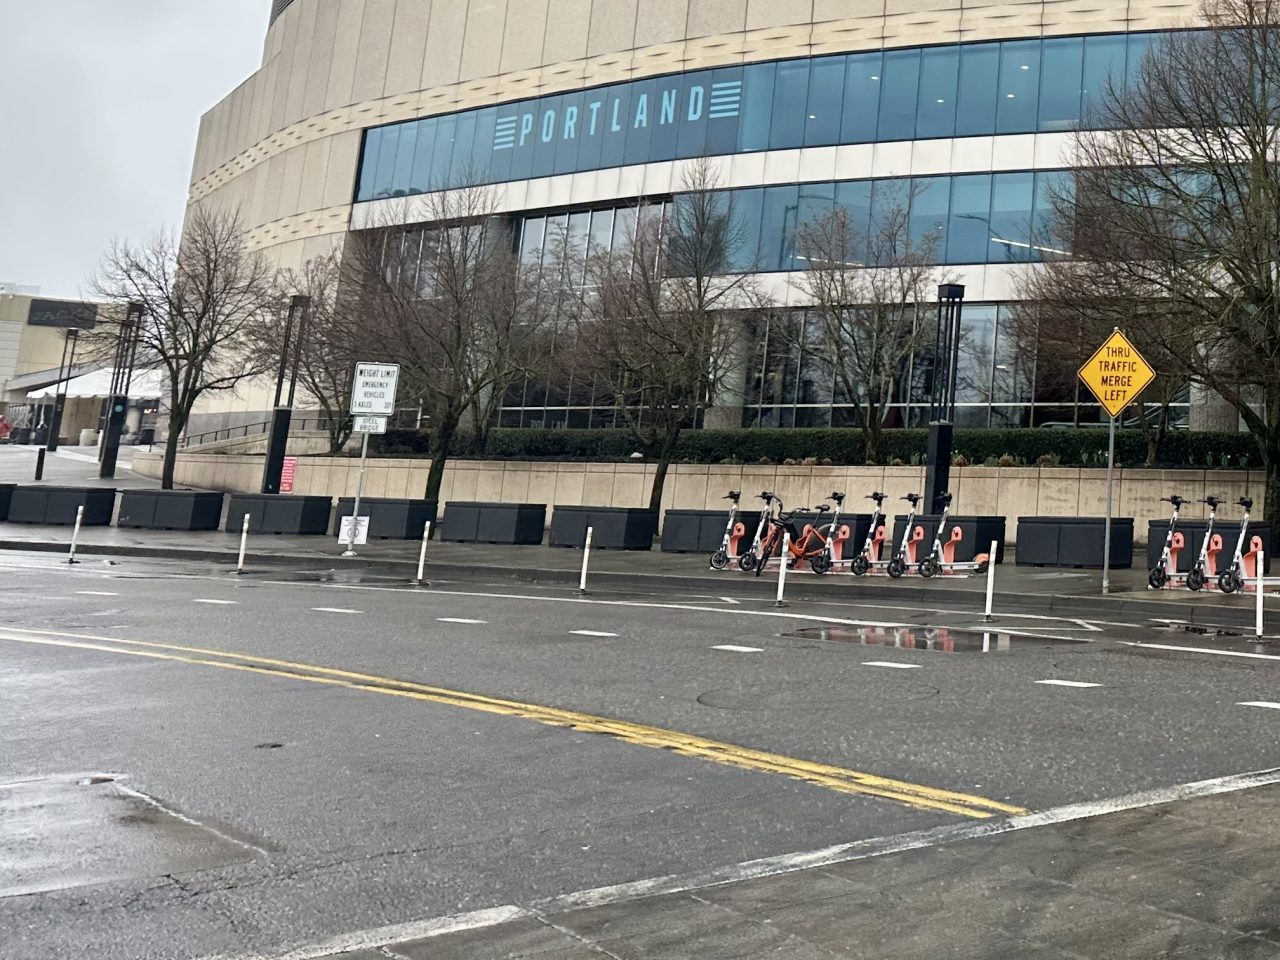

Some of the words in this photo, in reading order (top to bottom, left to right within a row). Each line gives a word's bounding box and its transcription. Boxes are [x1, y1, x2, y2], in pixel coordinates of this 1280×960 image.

[519, 85, 705, 147] PORTLAND
[1106, 346, 1131, 358] THRU
[1099, 361, 1137, 373] TRAFFIC
[359, 368, 379, 378] WEIGHT
[381, 370, 396, 379] LIMIT
[1101, 375, 1132, 387] MERGE
[1104, 389, 1127, 401] LEFT
